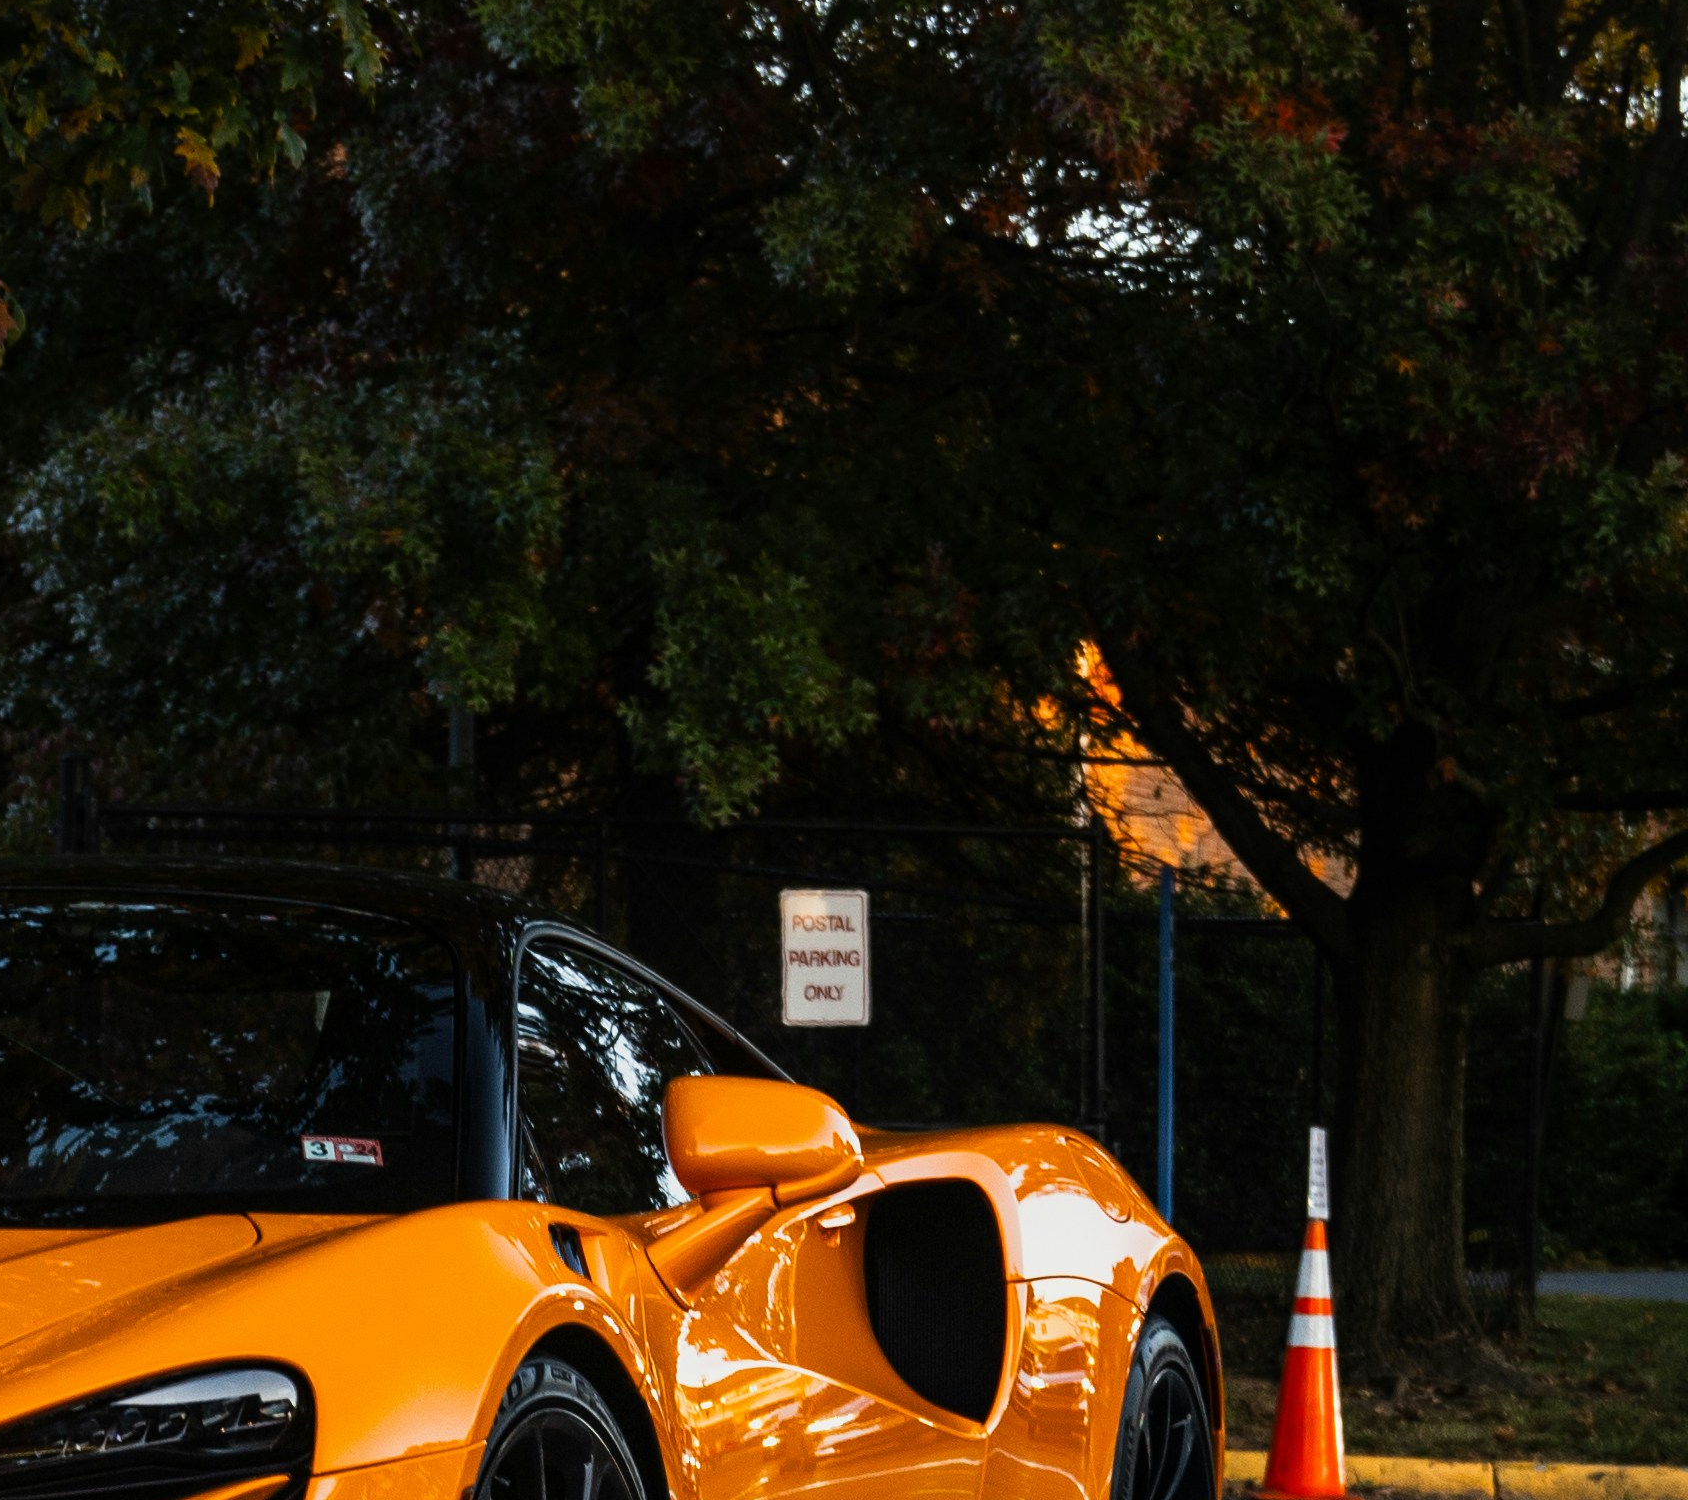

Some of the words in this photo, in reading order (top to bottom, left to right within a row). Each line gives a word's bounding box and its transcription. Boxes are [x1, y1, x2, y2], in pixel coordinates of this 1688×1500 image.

[792, 915, 855, 932] POSTAL
[789, 949, 860, 967] PARKING
[804, 984, 845, 1001] ONLY
[310, 1141, 328, 1156] 3
[356, 1143, 379, 1156] 24
